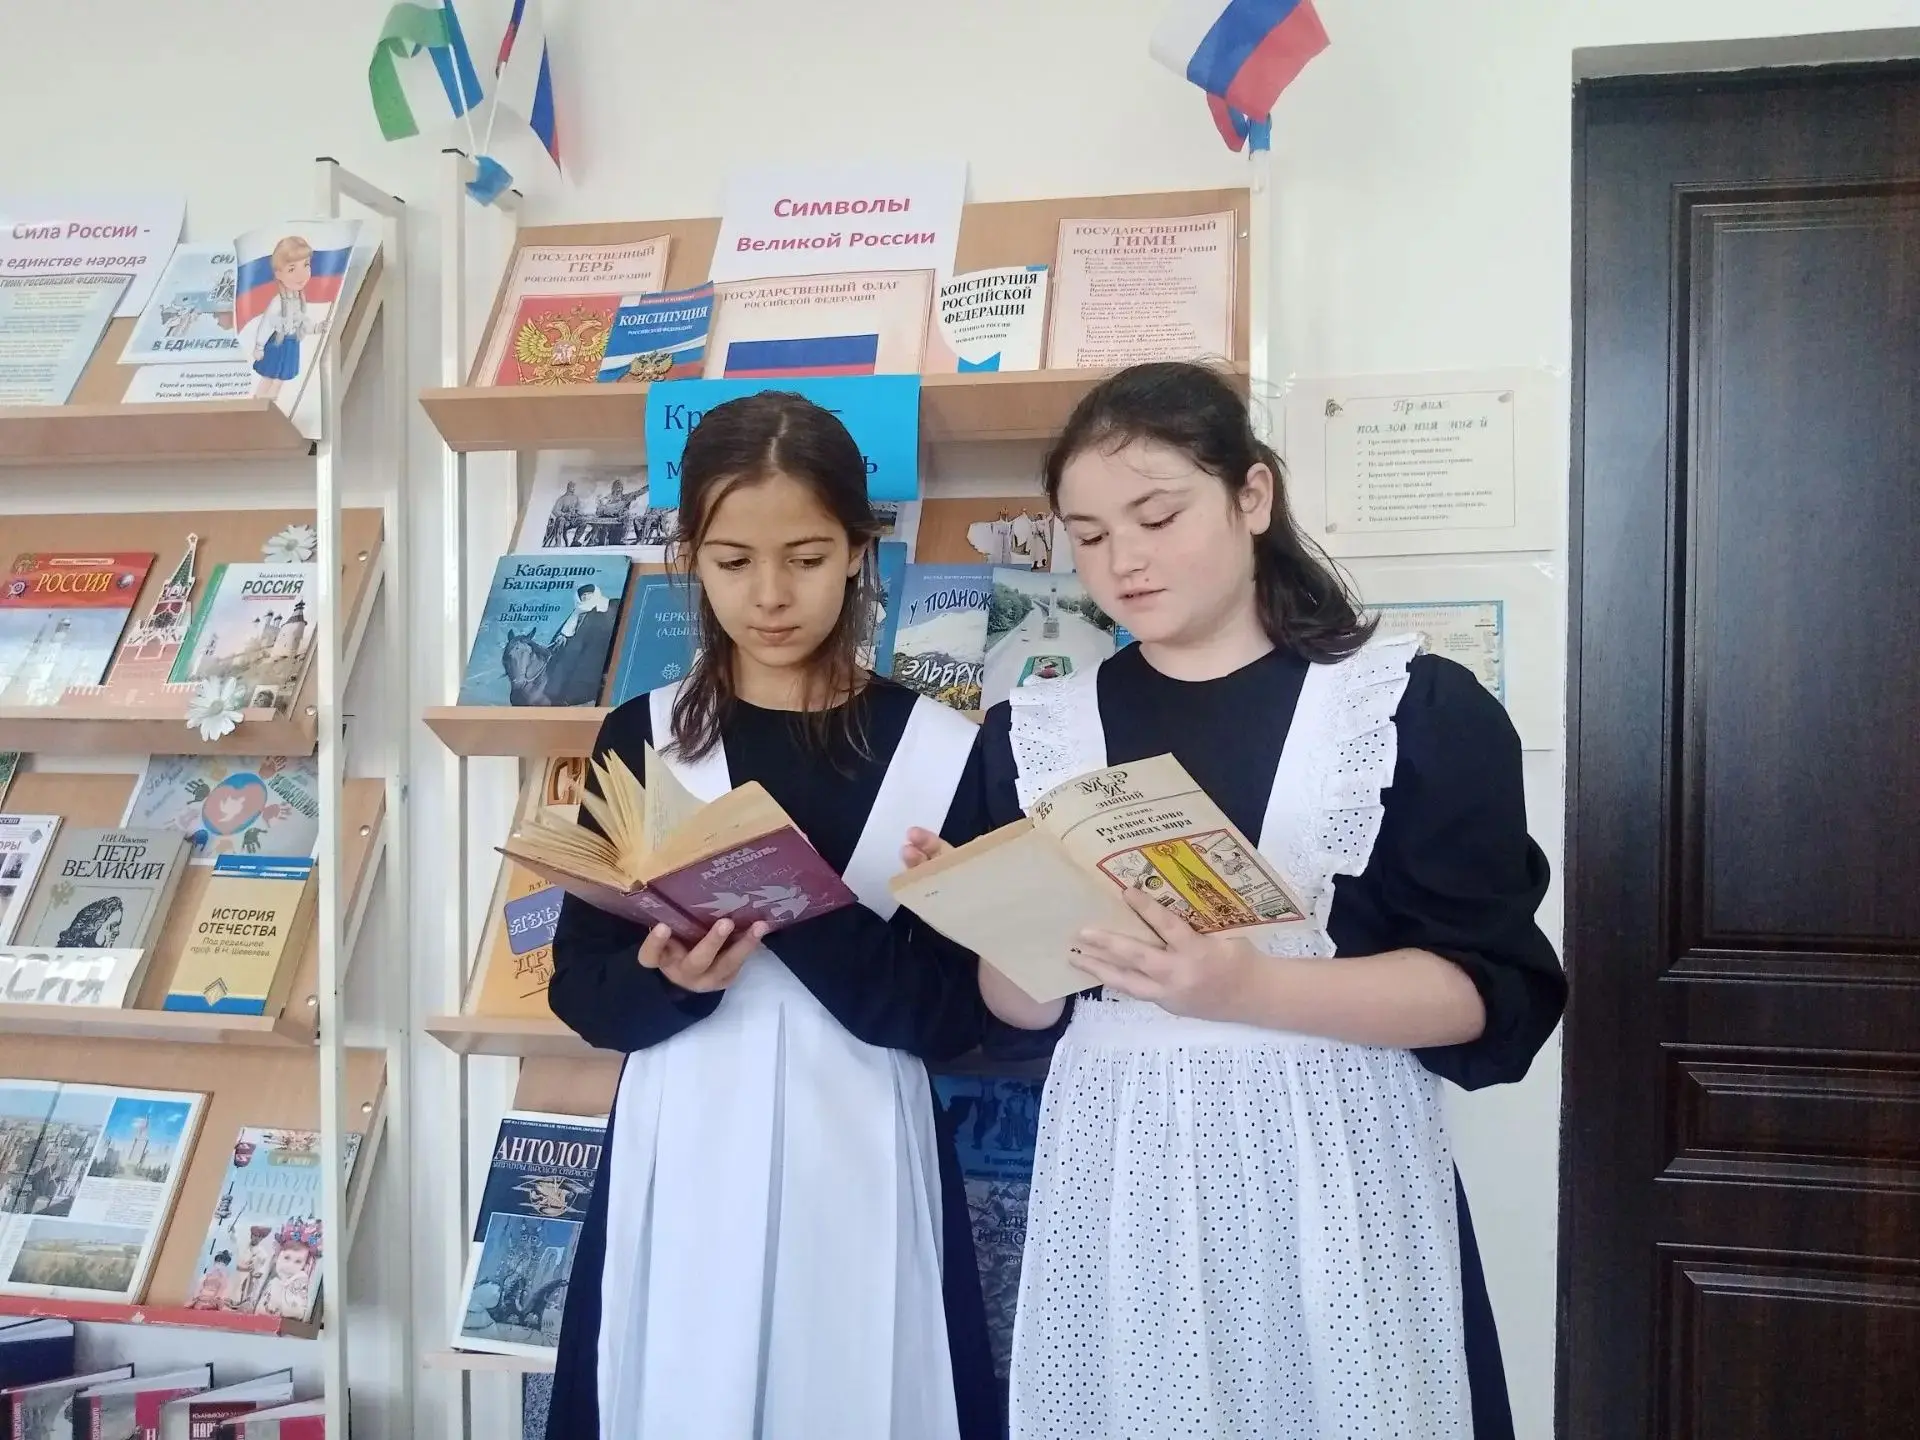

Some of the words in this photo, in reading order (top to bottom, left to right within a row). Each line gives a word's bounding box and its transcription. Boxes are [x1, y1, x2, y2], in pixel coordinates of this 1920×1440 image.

[774, 198, 910, 218] Символы
[12, 222, 61, 240] Сила
[67, 222, 138, 240] России
[1075, 220, 1217, 235] ГОСУДАРСТВЕННЫЙ
[736, 232, 841, 252] Великой
[849, 231, 936, 247] России
[1114, 235, 1176, 246] ГИМН
[531, 246, 655, 262] ГОСУДАРСТВЕННЫЙ
[1073, 247, 1146, 255] РОССИЙСКОЙ
[1150, 245, 1217, 254] ФЕДЕРАЦИИ
[7, 255, 82, 269] единстве
[86, 255, 147, 269] народа
[568, 262, 615, 273] ГЕРБ
[524, 274, 590, 283] РОССИЙСКОЙ
[592, 272, 652, 281] ФЕДЕРАЦИИ
[940, 273, 1037, 298] КОНСТИТУЦИЯ
[724, 281, 856, 300] ГОСУДАРСТВЕННЫЙ
[862, 281, 900, 291] ФЛАГ
[942, 286, 1032, 311] РОССИЙСКОЙ
[744, 298, 811, 309] РОССИЙСКОЙ
[814, 293, 876, 305] ФЕДЕРАЦИИ
[619, 306, 709, 326] КОНСТИТУЦИЯ
[944, 304, 1025, 323] ФЕДЕРАЦИИ
[152, 340, 161, 351] В
[164, 338, 240, 350] ЕДИНСТВЕ
[515, 564, 602, 579] Кабардино-
[34, 572, 115, 593] РОССИЯ
[241, 580, 304, 594] РОССИЯ
[501, 577, 575, 592] Балкария
[508, 603, 560, 612] Kabardino
[499, 613, 549, 624] Balkariya
[1096, 791, 1144, 808] знаний
[1096, 818, 1146, 837] Русское
[1149, 810, 1184, 824] слово
[1106, 836, 1116, 844] в
[1117, 826, 1161, 842] языках
[1162, 818, 1192, 833] мира
[92, 844, 146, 862] ПЕТР
[61, 859, 165, 879] ВЕЛИКИЙ
[211, 908, 276, 922] ИСТОРИЯ
[510, 903, 560, 936] ЯЗЫ
[198, 922, 277, 937] ОТЕЧЕСТВА
[202, 937, 219, 946] Под
[219, 938, 265, 948] редакцией
